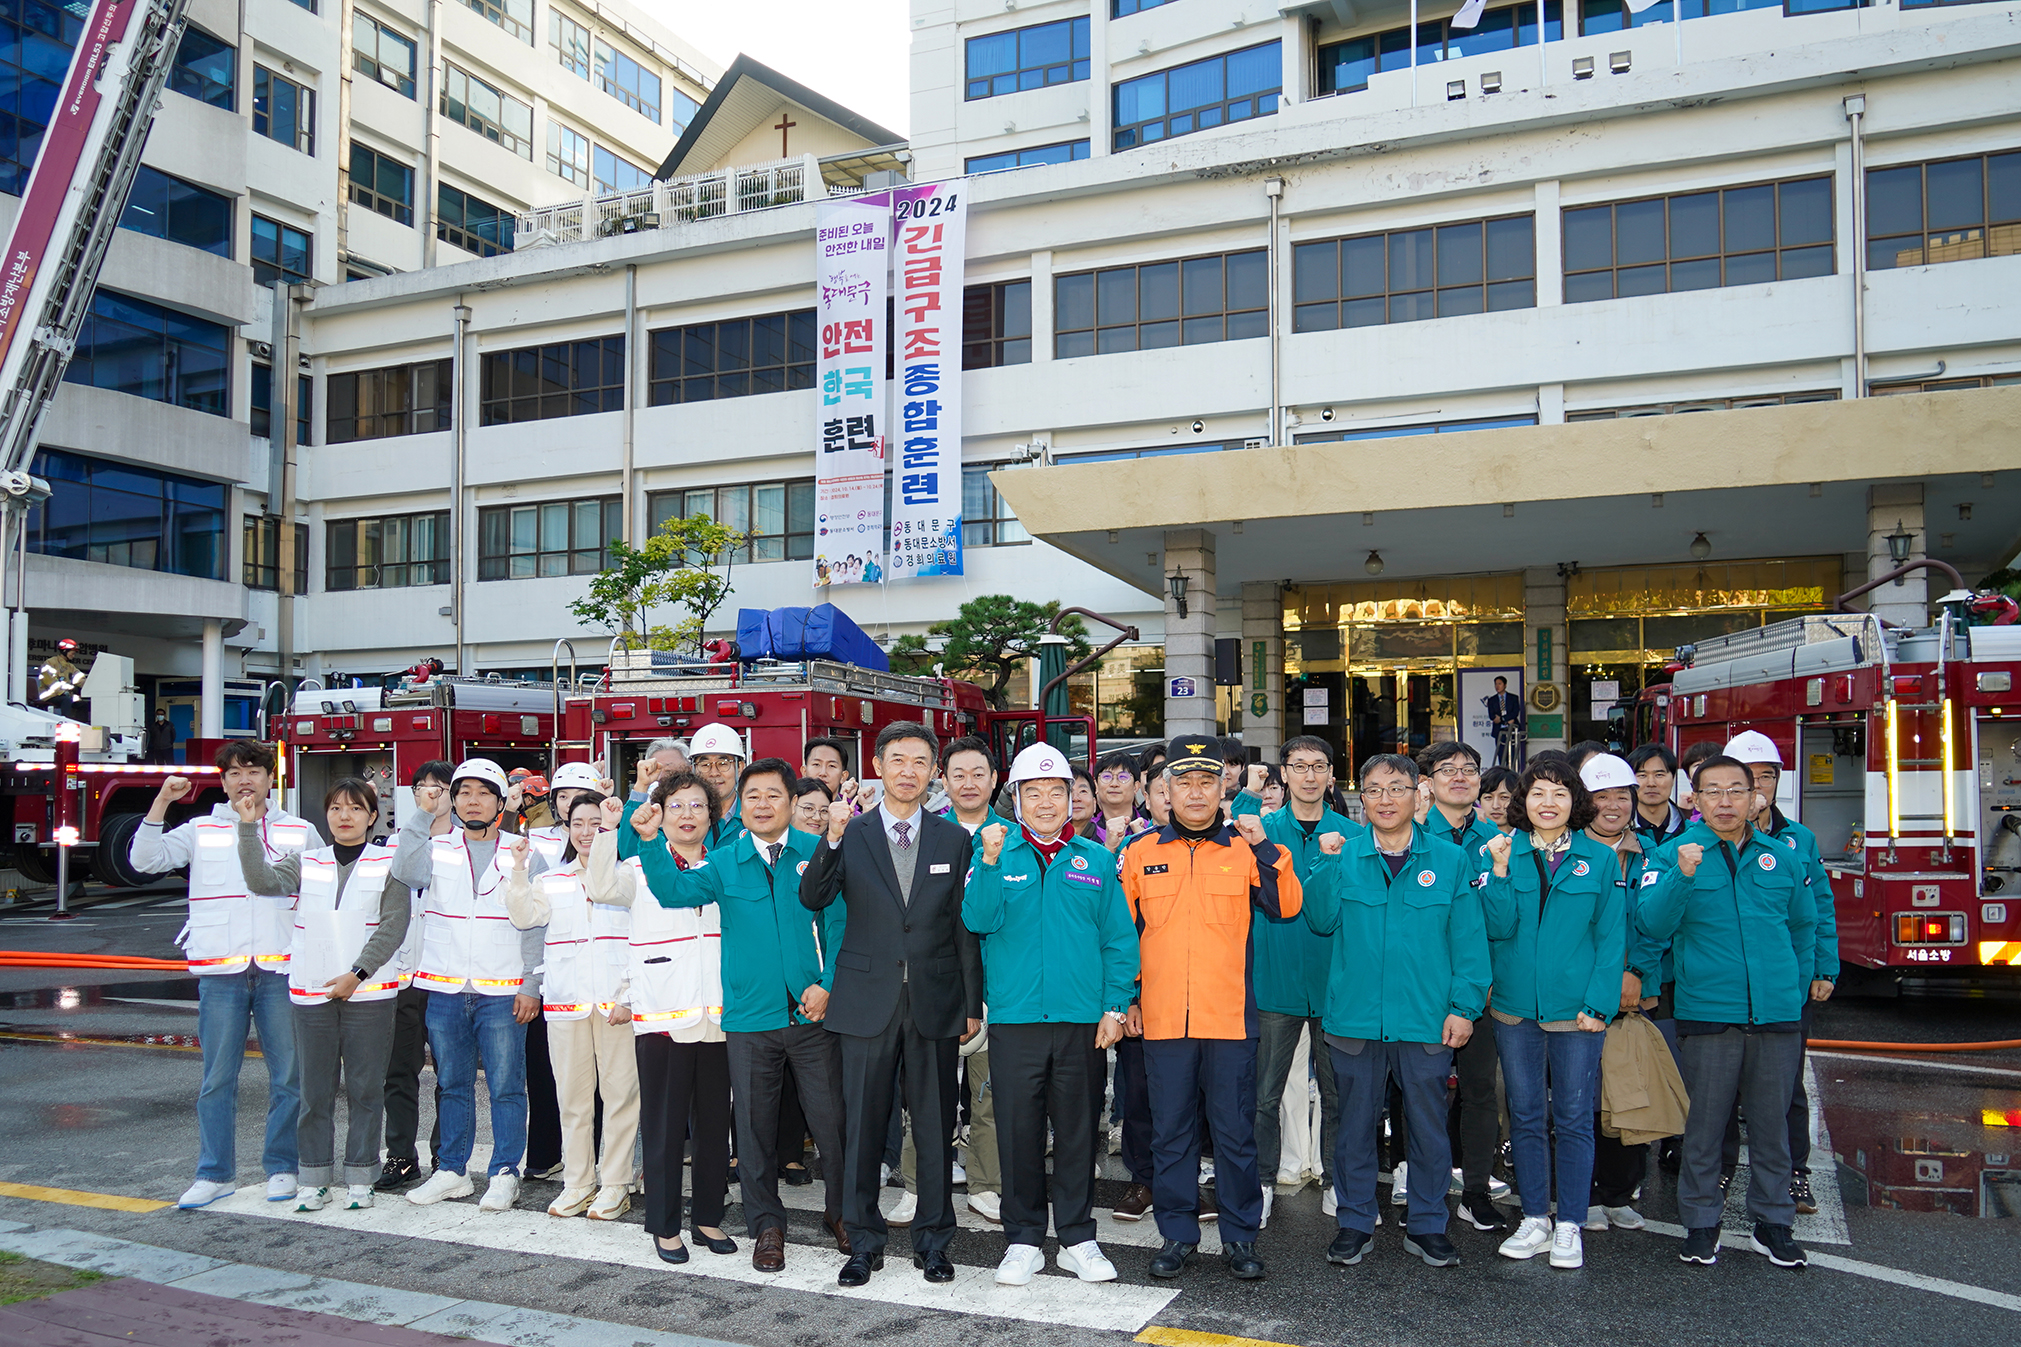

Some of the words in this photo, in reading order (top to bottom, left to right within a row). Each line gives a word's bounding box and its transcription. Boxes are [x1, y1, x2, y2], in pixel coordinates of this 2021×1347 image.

[88, 43, 103, 69] ERL53
[897, 194, 958, 221] 2024
[819, 225, 849, 242] 준비된
[852, 222, 874, 235] 오늘
[825, 240, 858, 257] 안전한
[861, 237, 885, 250] 내일
[0, 251, 31, 326] 소방재난본부
[822, 280, 871, 309] 동대문구
[822, 318, 873, 360] 안전
[823, 366, 873, 406] 한국
[823, 414, 875, 454] 훈련
[904, 536, 956, 551] 동대문소방서
[906, 552, 957, 567] 경희의료원
[1177, 687, 1189, 695] 23
[1906, 949, 1952, 962] 서울소방
